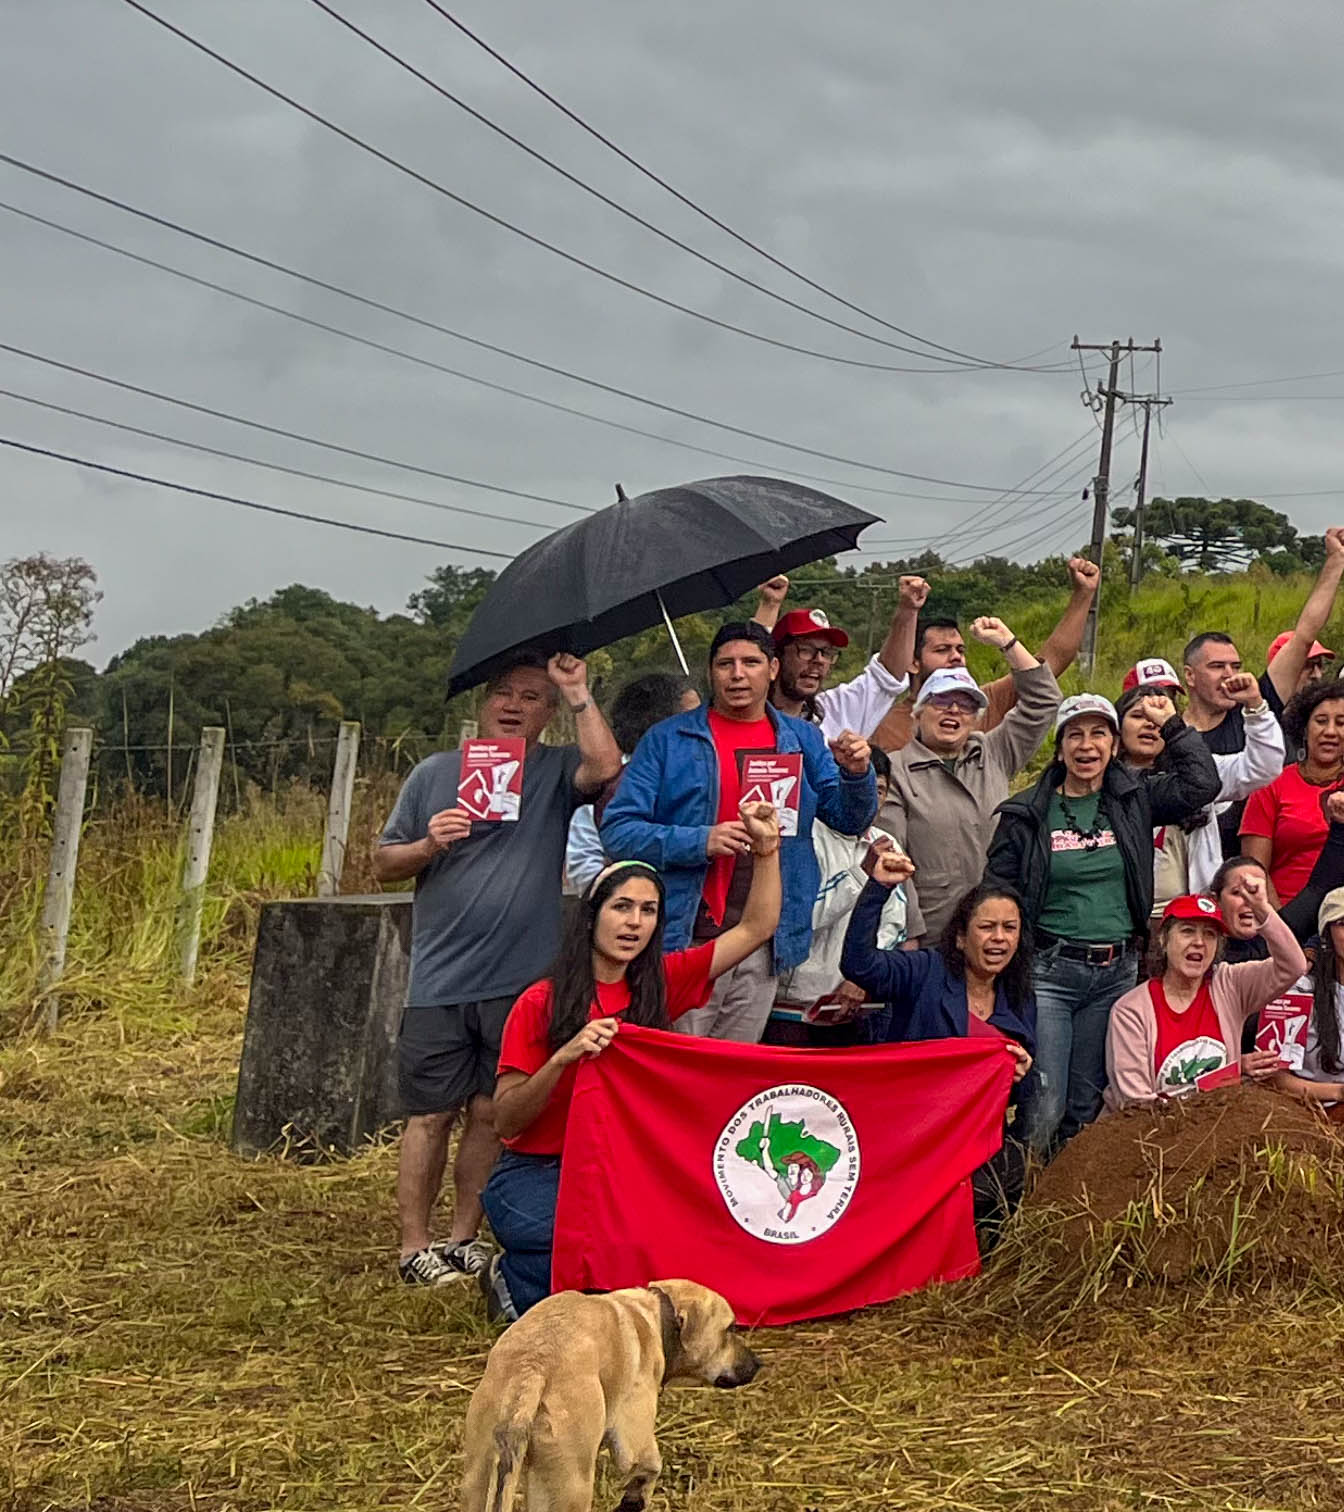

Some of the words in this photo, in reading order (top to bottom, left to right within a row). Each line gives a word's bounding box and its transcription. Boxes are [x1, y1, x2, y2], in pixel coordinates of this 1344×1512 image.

[748, 1087, 838, 1113] TRABALHADORES
[728, 1112, 748, 1135] DOS
[836, 1112, 857, 1152] RURAIS
[716, 1138, 739, 1208] MOVIMENTO
[848, 1156, 857, 1182] SEM
[826, 1185, 852, 1220] TERRA
[764, 1227, 800, 1239] BRASIL
